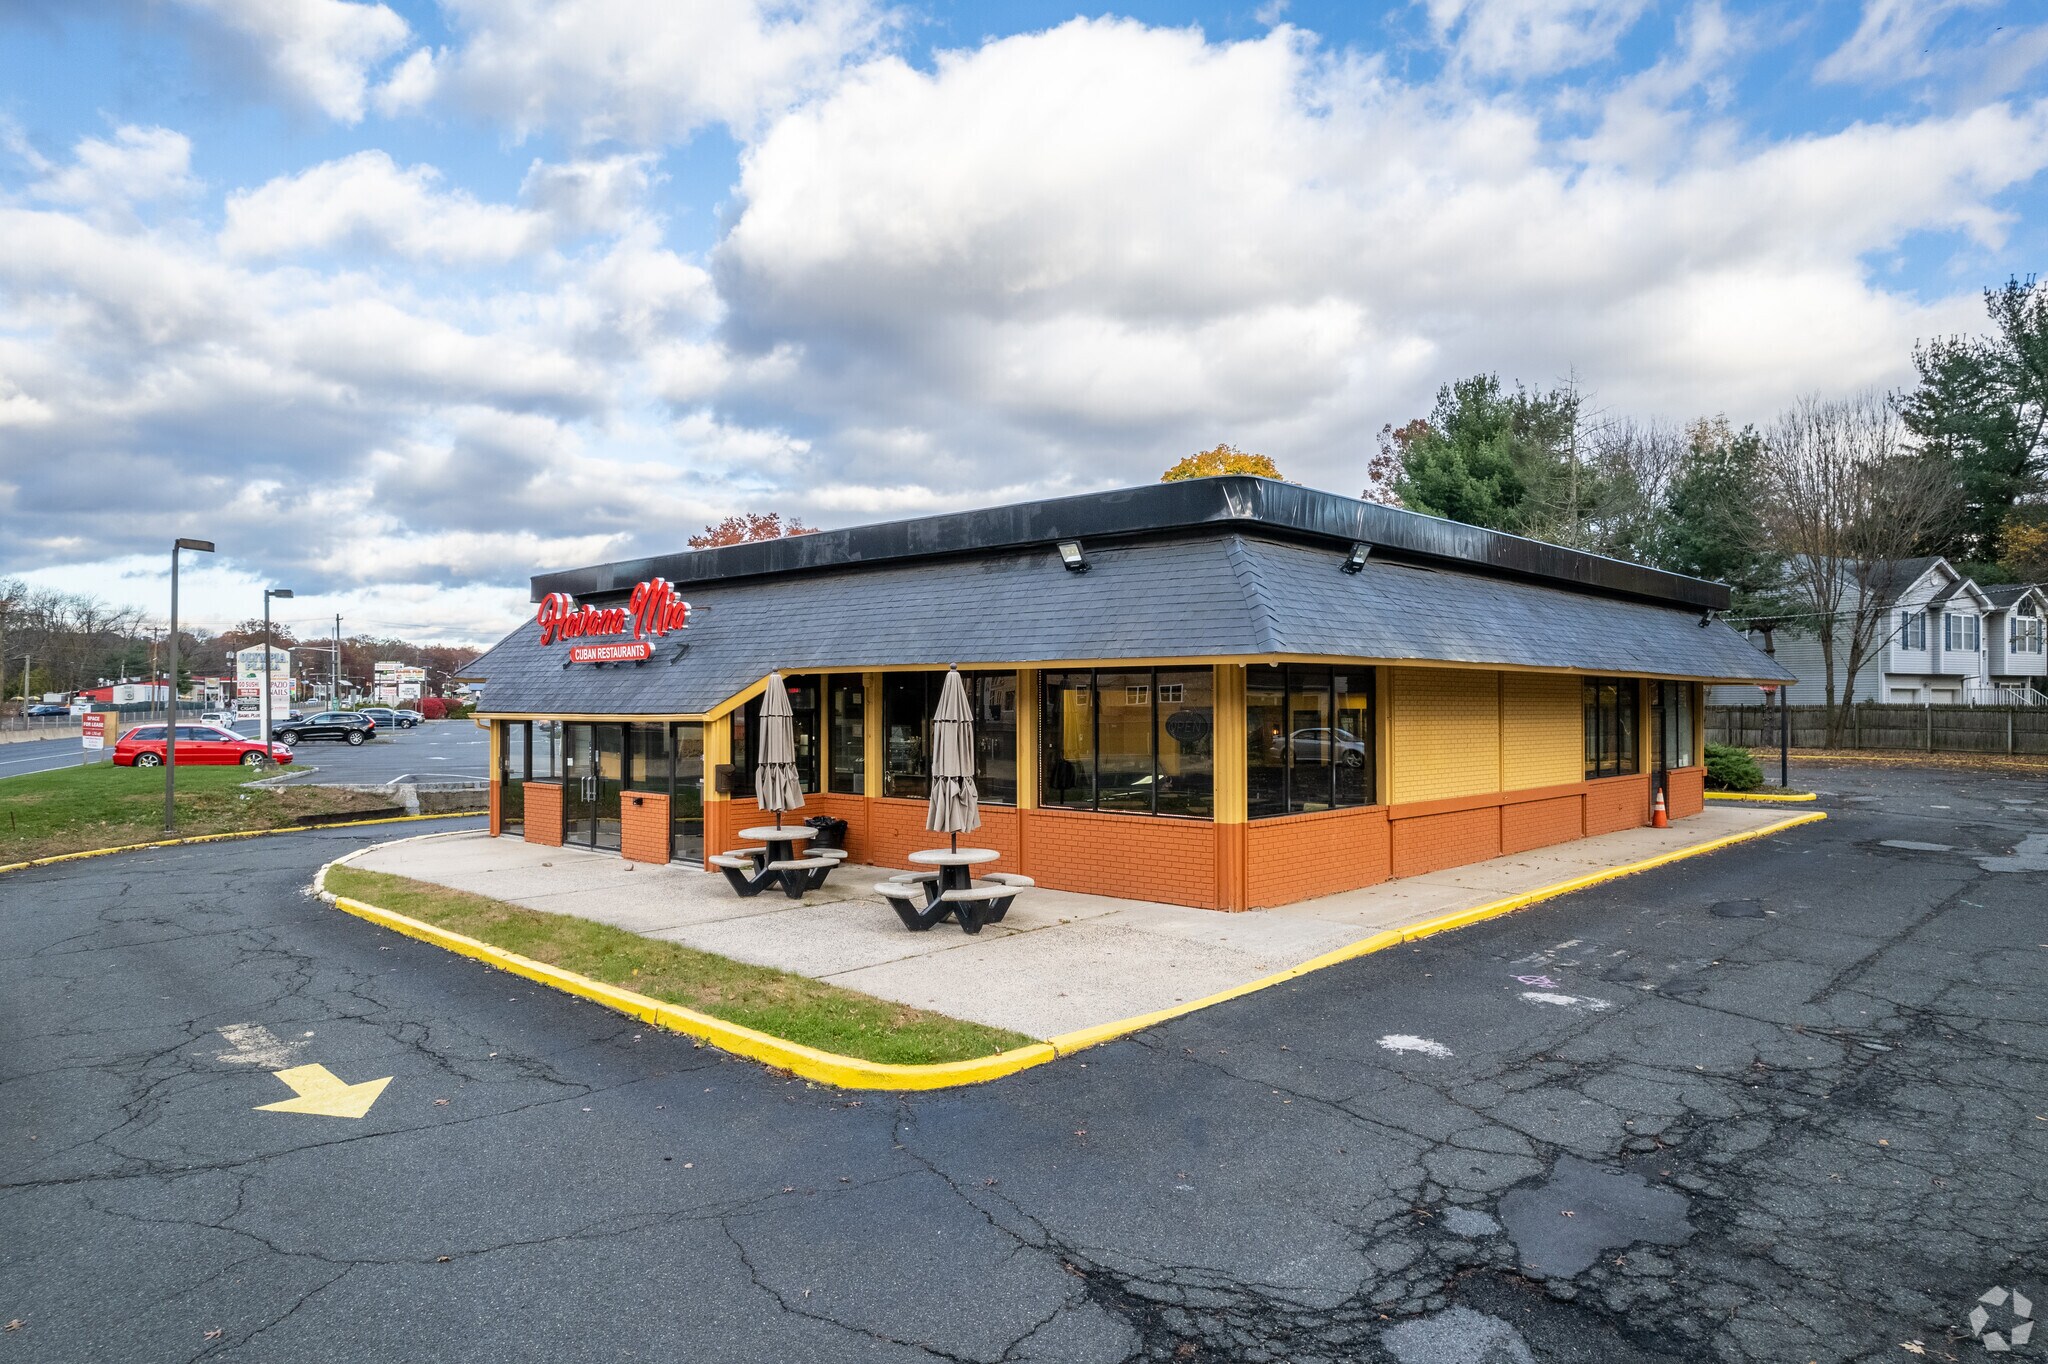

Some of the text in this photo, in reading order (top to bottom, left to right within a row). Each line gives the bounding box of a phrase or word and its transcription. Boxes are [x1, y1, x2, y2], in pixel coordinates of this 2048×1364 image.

[537, 577, 691, 646] Havana Mia
[575, 644, 645, 660] CUBAN RESTAURANTS
[1169, 720, 1201, 733] OPEN
